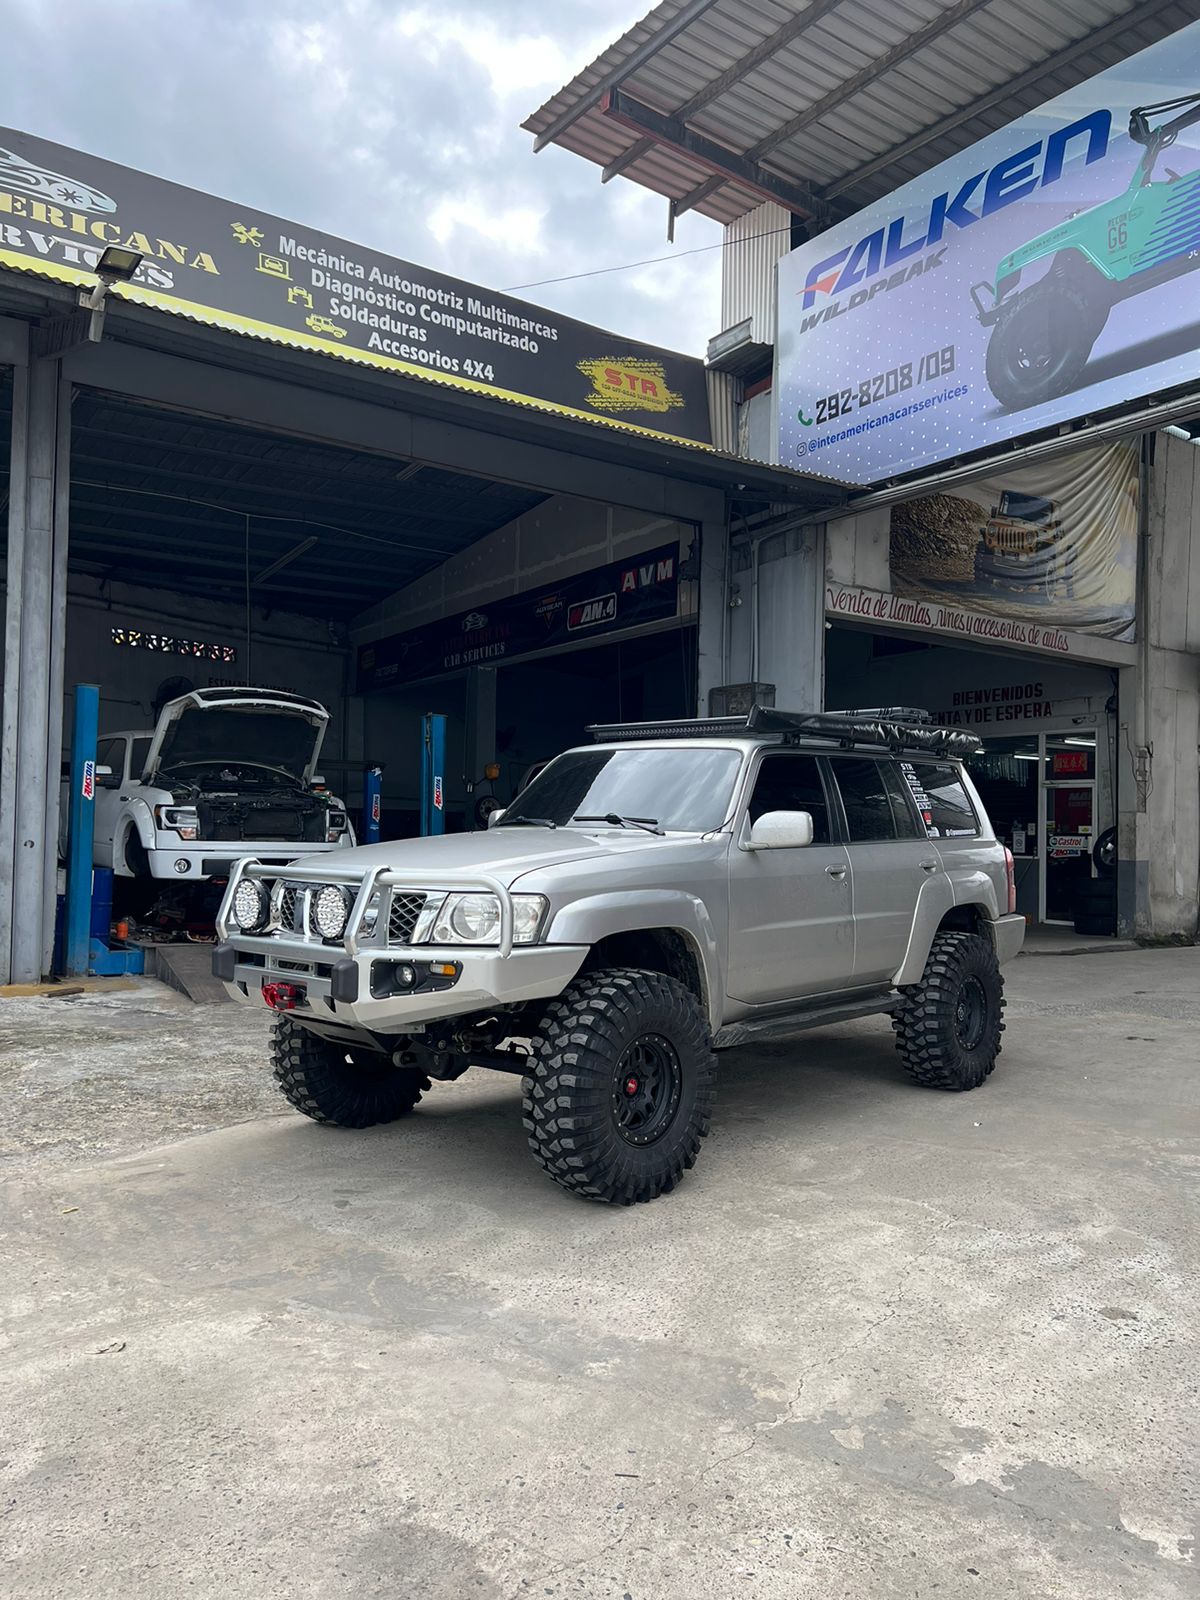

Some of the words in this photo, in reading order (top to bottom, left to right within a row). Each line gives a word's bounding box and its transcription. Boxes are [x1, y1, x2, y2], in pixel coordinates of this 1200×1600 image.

[796, 109, 1113, 311] FALKEN
[279, 235, 364, 279] Mecánica
[368, 266, 464, 311] Automotriz
[467, 297, 558, 341] Multimarcas
[311, 268, 417, 317] Diagnóstico
[419, 304, 539, 354] Computarizado
[799, 247, 948, 335] WILDPEAK
[329, 297, 428, 342] Soldaduras
[368, 331, 460, 372] Accesorios
[462, 358, 495, 382] 4X4
[604, 367, 657, 398] STR
[815, 362, 913, 425] 292-8208
[808, 384, 968, 452] @interamericanacarsservices
[621, 558, 674, 593] AVM
[827, 587, 871, 616] Venta
[873, 593, 887, 618] de
[935, 607, 965, 631] rines
[973, 617, 1026, 643] accesorios
[1028, 623, 1040, 645] de
[1042, 629, 1069, 651] autos
[462, 641, 506, 665] SERVICES
[930, 711, 961, 726] ENTA
[963, 709, 972, 724] Y
[975, 707, 992, 723] DE
[996, 702, 1052, 721] ESPERA
[953, 682, 1043, 706] BIENVENIDOS
[83, 762, 94, 797] AMSOIL
[1057, 837, 1082, 846] Castrol
